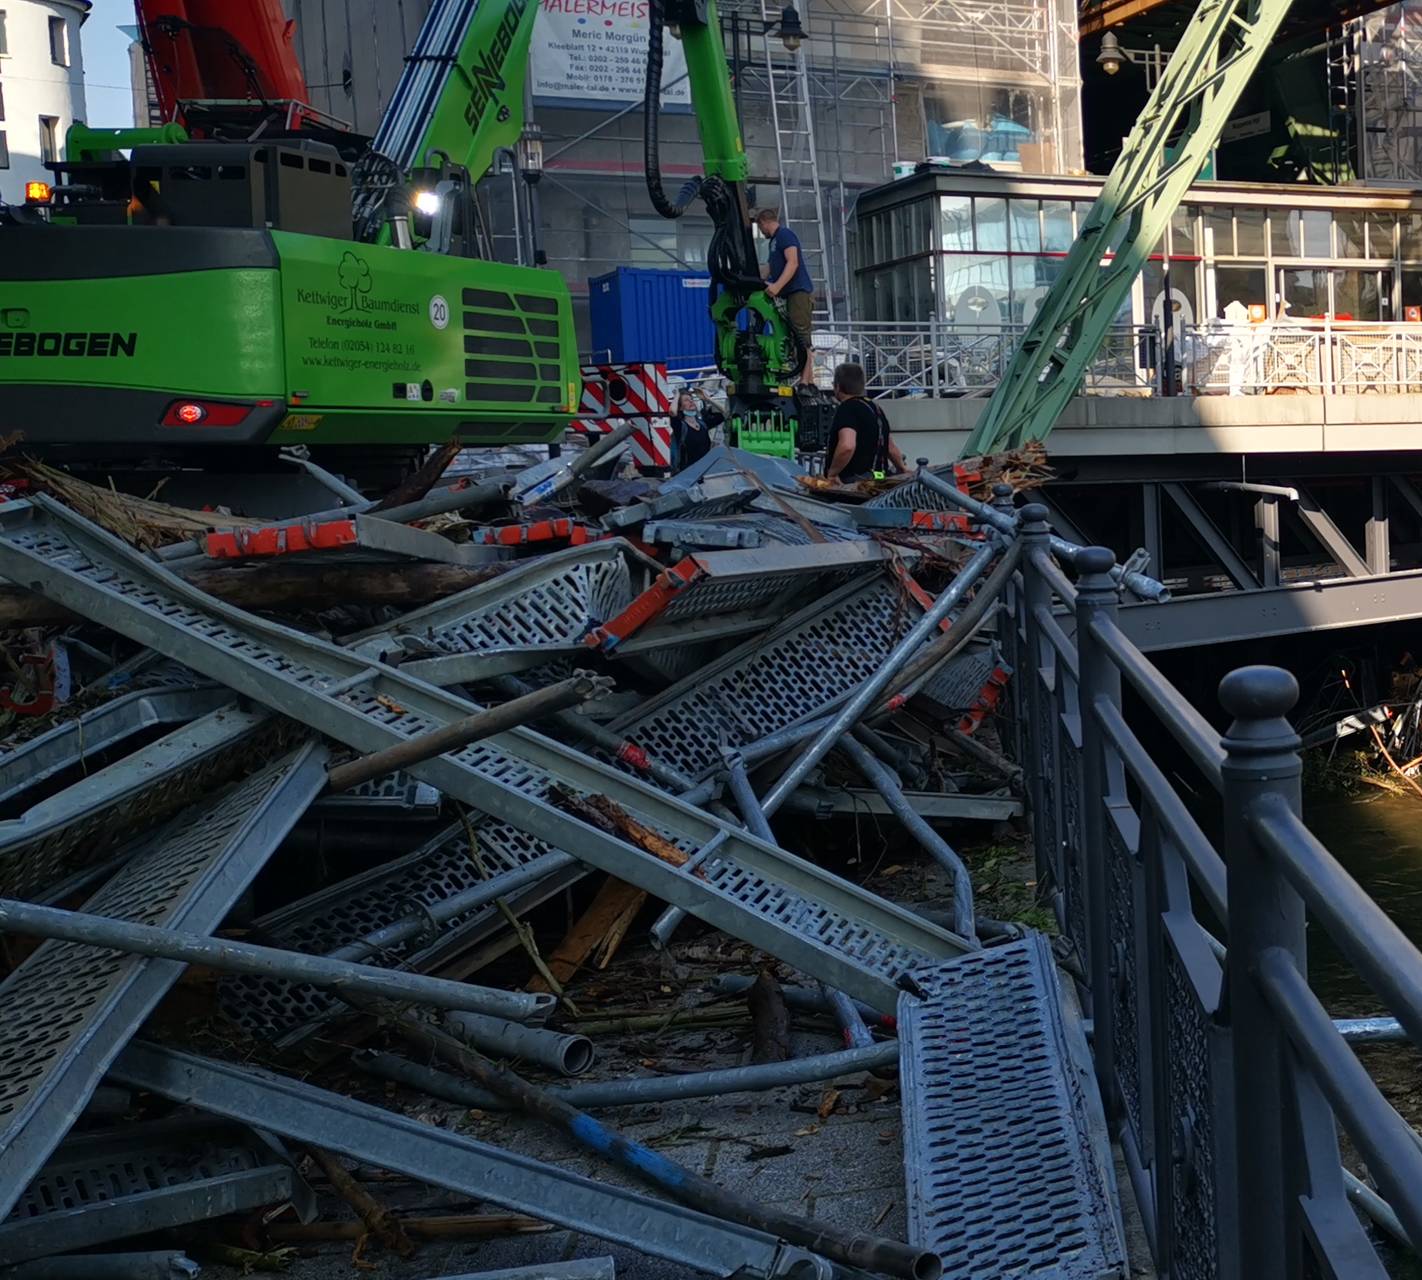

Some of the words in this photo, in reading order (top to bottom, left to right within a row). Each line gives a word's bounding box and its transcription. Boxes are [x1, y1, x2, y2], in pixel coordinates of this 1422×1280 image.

[572, 29, 602, 40] Meric
[605, 31, 646, 44] Morgün
[548, 42, 584, 51] Kleeblatt
[587, 44, 597, 52] 12
[589, 64, 609, 73] 0202
[296, 288, 348, 309] Kettwiger
[361, 295, 420, 315] Baumdienst
[432, 302, 446, 321] 20
[326, 316, 372, 329] Energieholz
[374, 319, 398, 331] GmbH
[308, 337, 340, 351] Telefon
